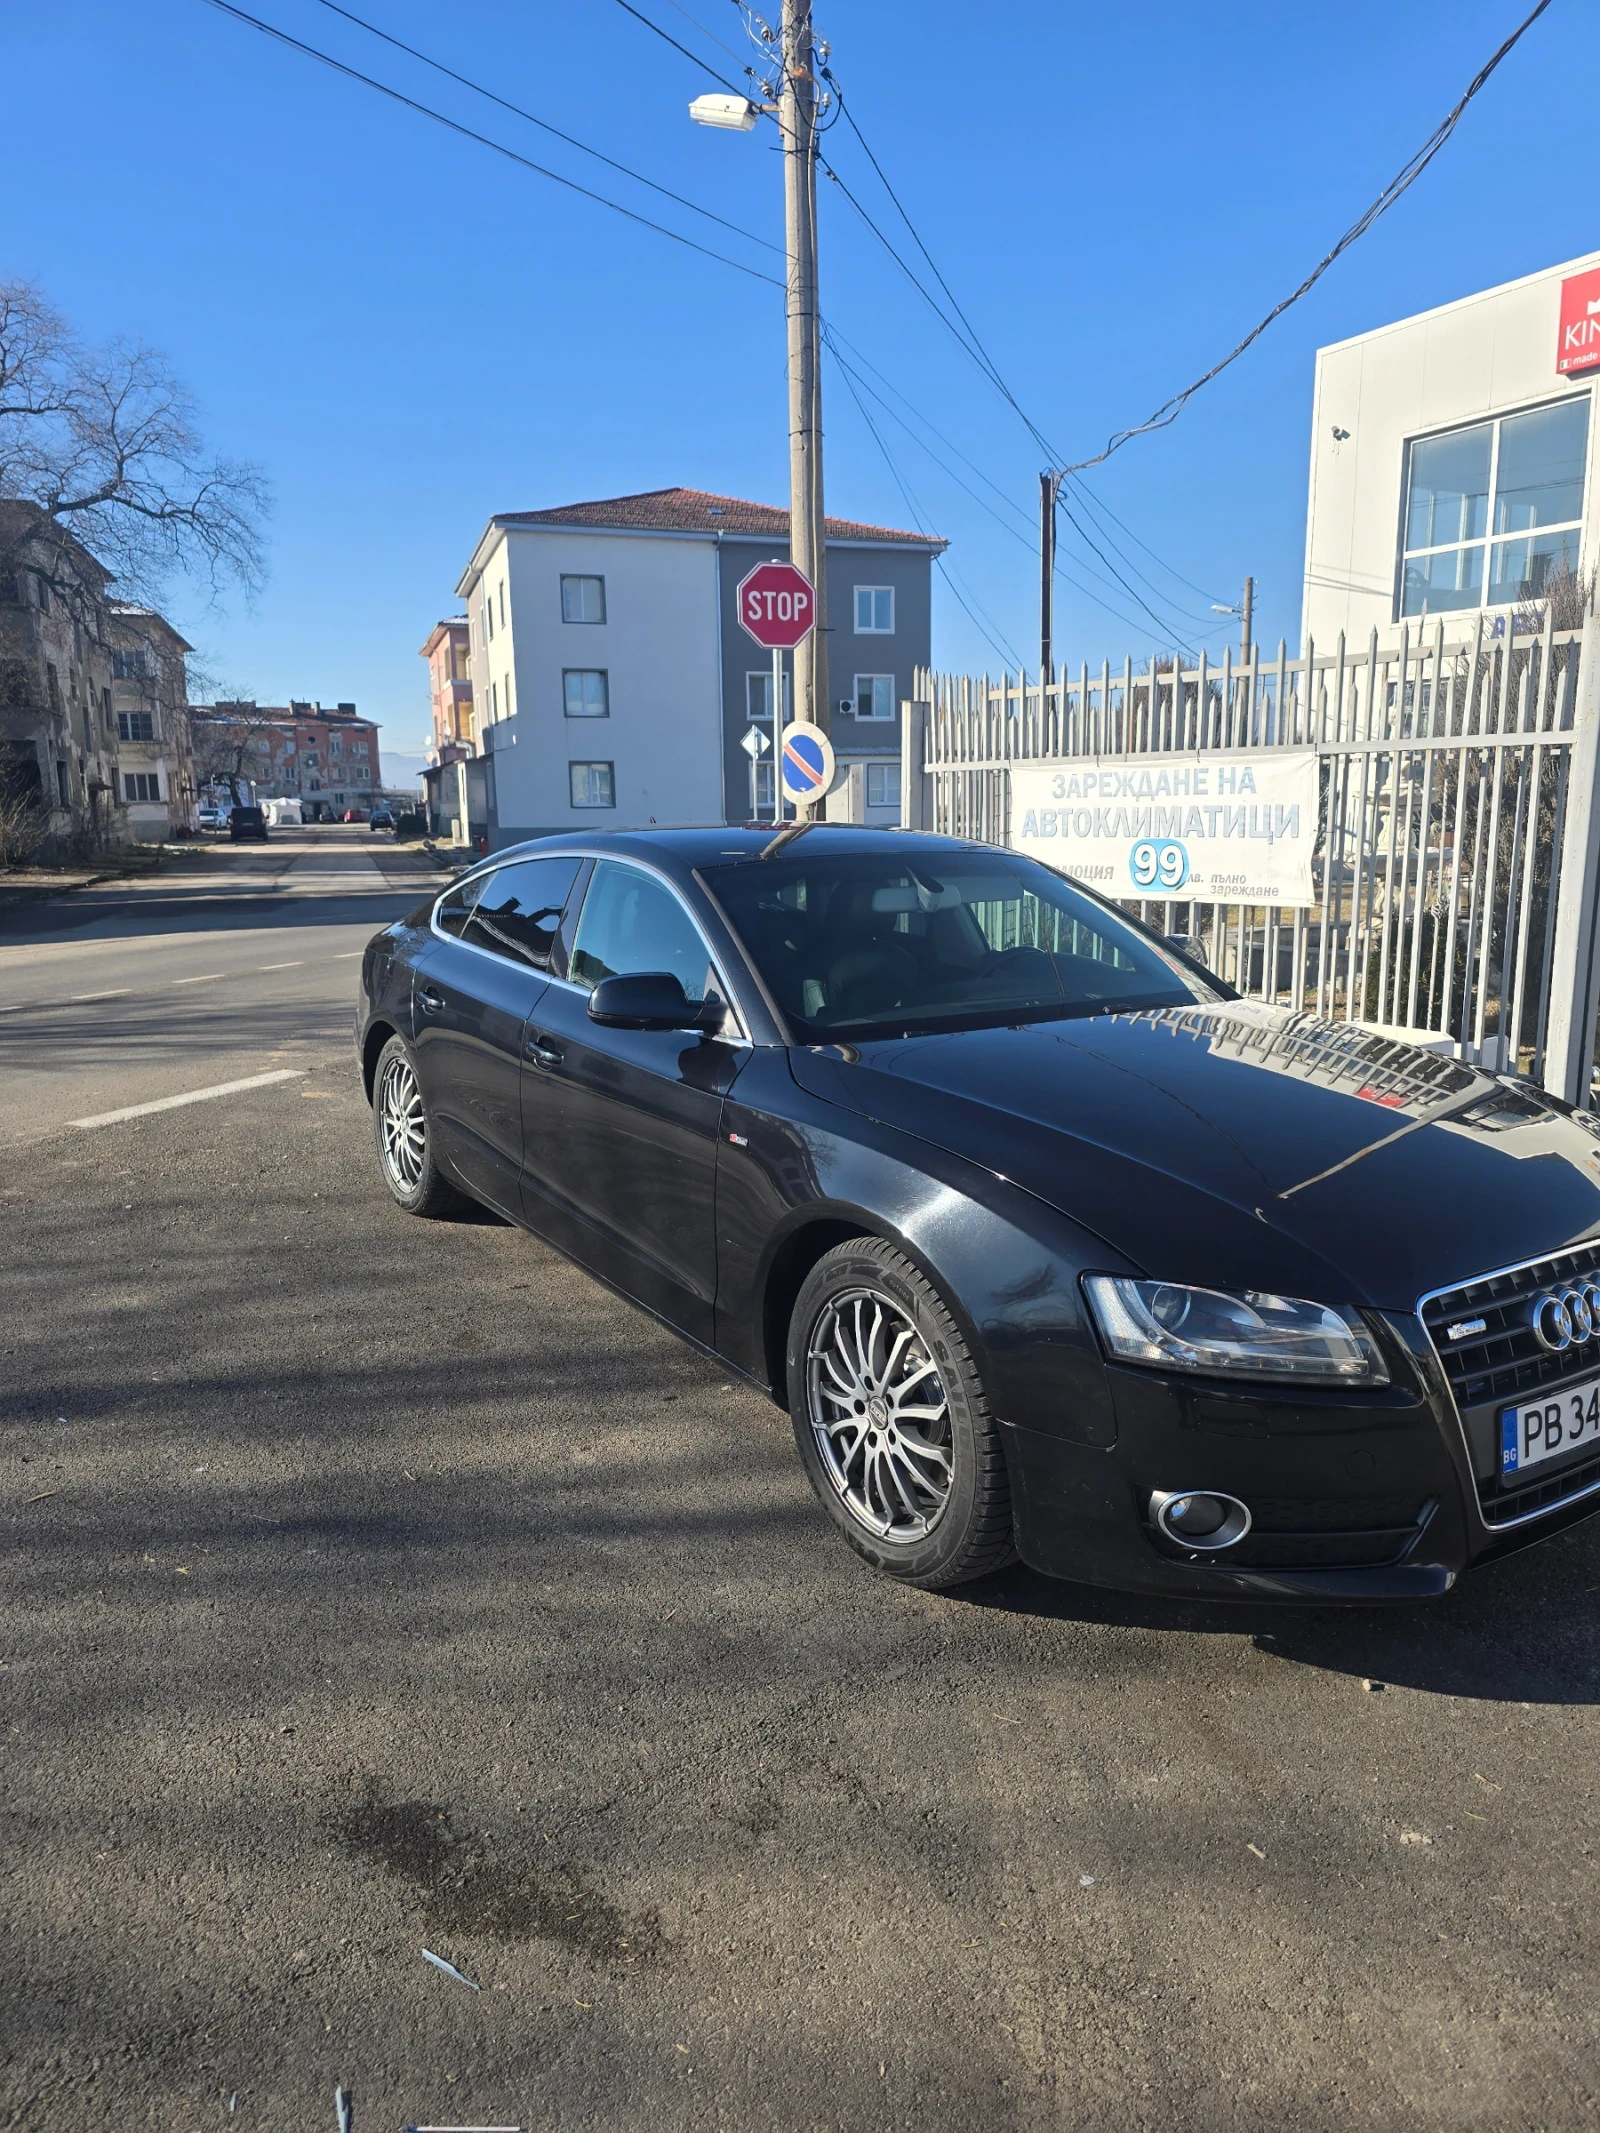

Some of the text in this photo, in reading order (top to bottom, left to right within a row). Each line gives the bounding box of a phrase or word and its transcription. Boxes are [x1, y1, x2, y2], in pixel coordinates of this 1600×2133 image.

[1573, 352, 1598, 364] made
[748, 590, 808, 622] STOP
[1051, 766, 1257, 802] ЗАРЕЖДАНЕ НА
[1021, 804, 1300, 845] АВТОКЛИМАТИЦИ
[1055, 865, 1115, 881] МОЦИЯ
[1134, 843, 1187, 887] 99
[1210, 873, 1247, 884] пълно
[1210, 884, 1279, 897] зареждане
[1524, 1403, 1562, 1459] PB
[1503, 1447, 1517, 1464] BG
